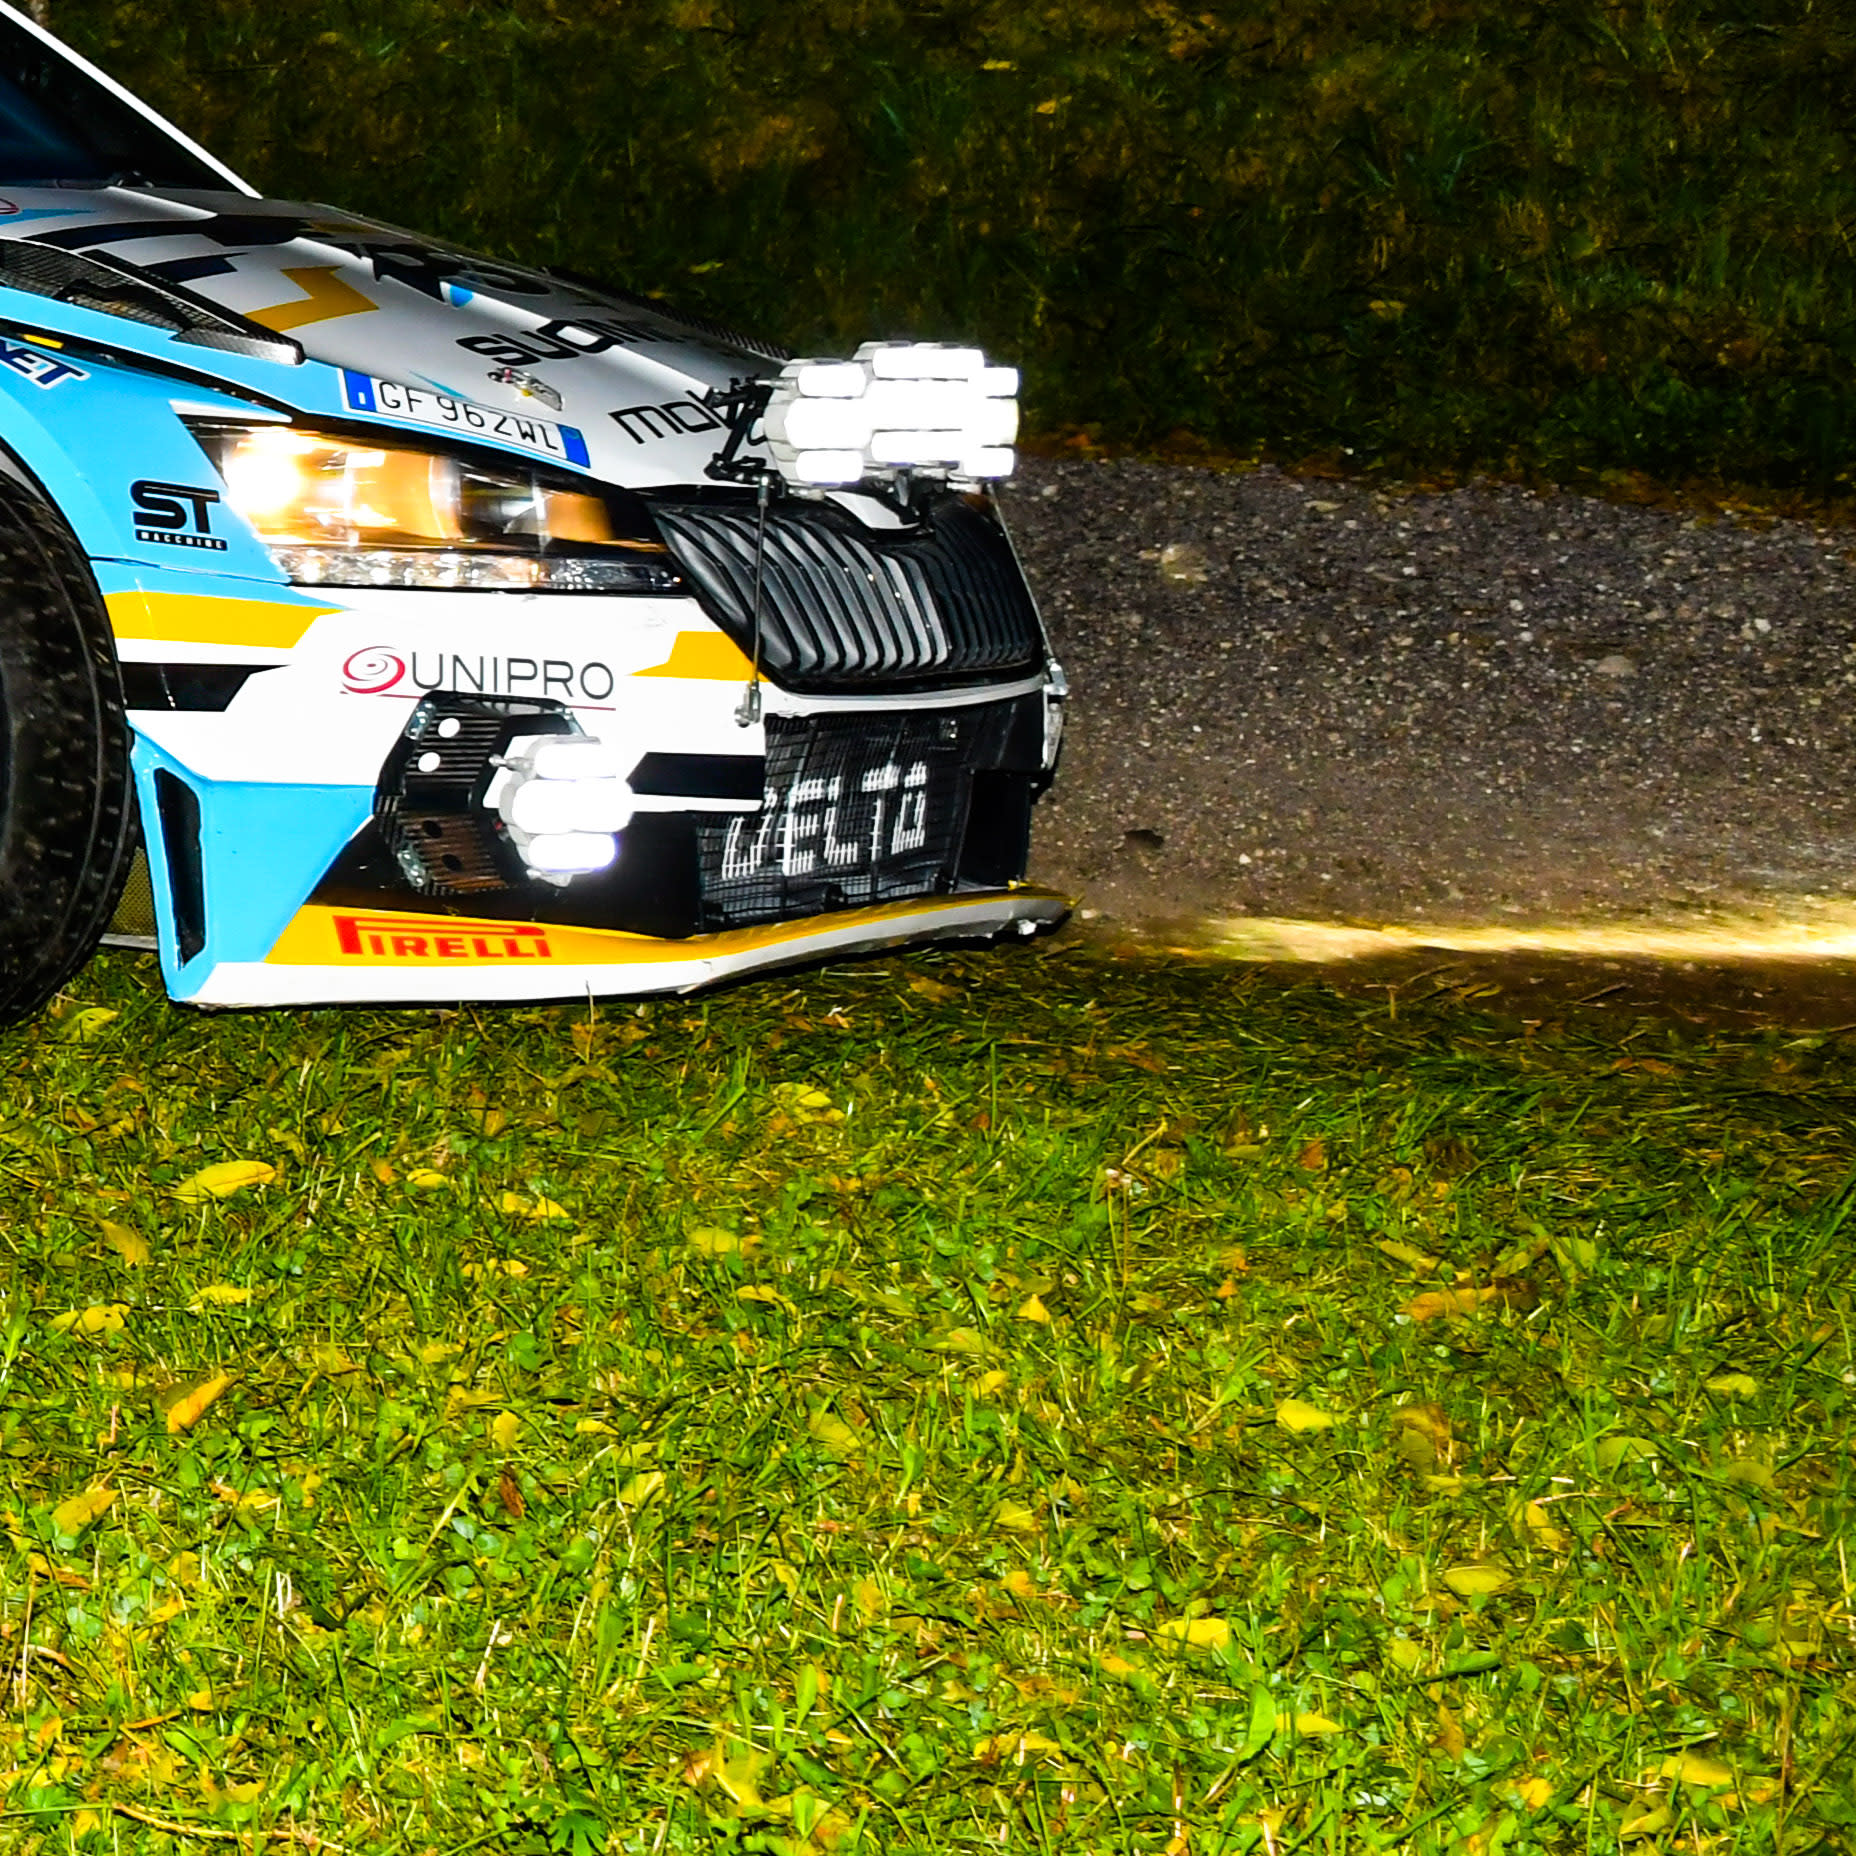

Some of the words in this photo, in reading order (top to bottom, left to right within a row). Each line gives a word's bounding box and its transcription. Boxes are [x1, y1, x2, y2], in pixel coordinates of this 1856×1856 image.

[130, 479, 221, 535] ST
[411, 651, 614, 700] UNIPRO
[333, 915, 552, 958] PIRELLI
